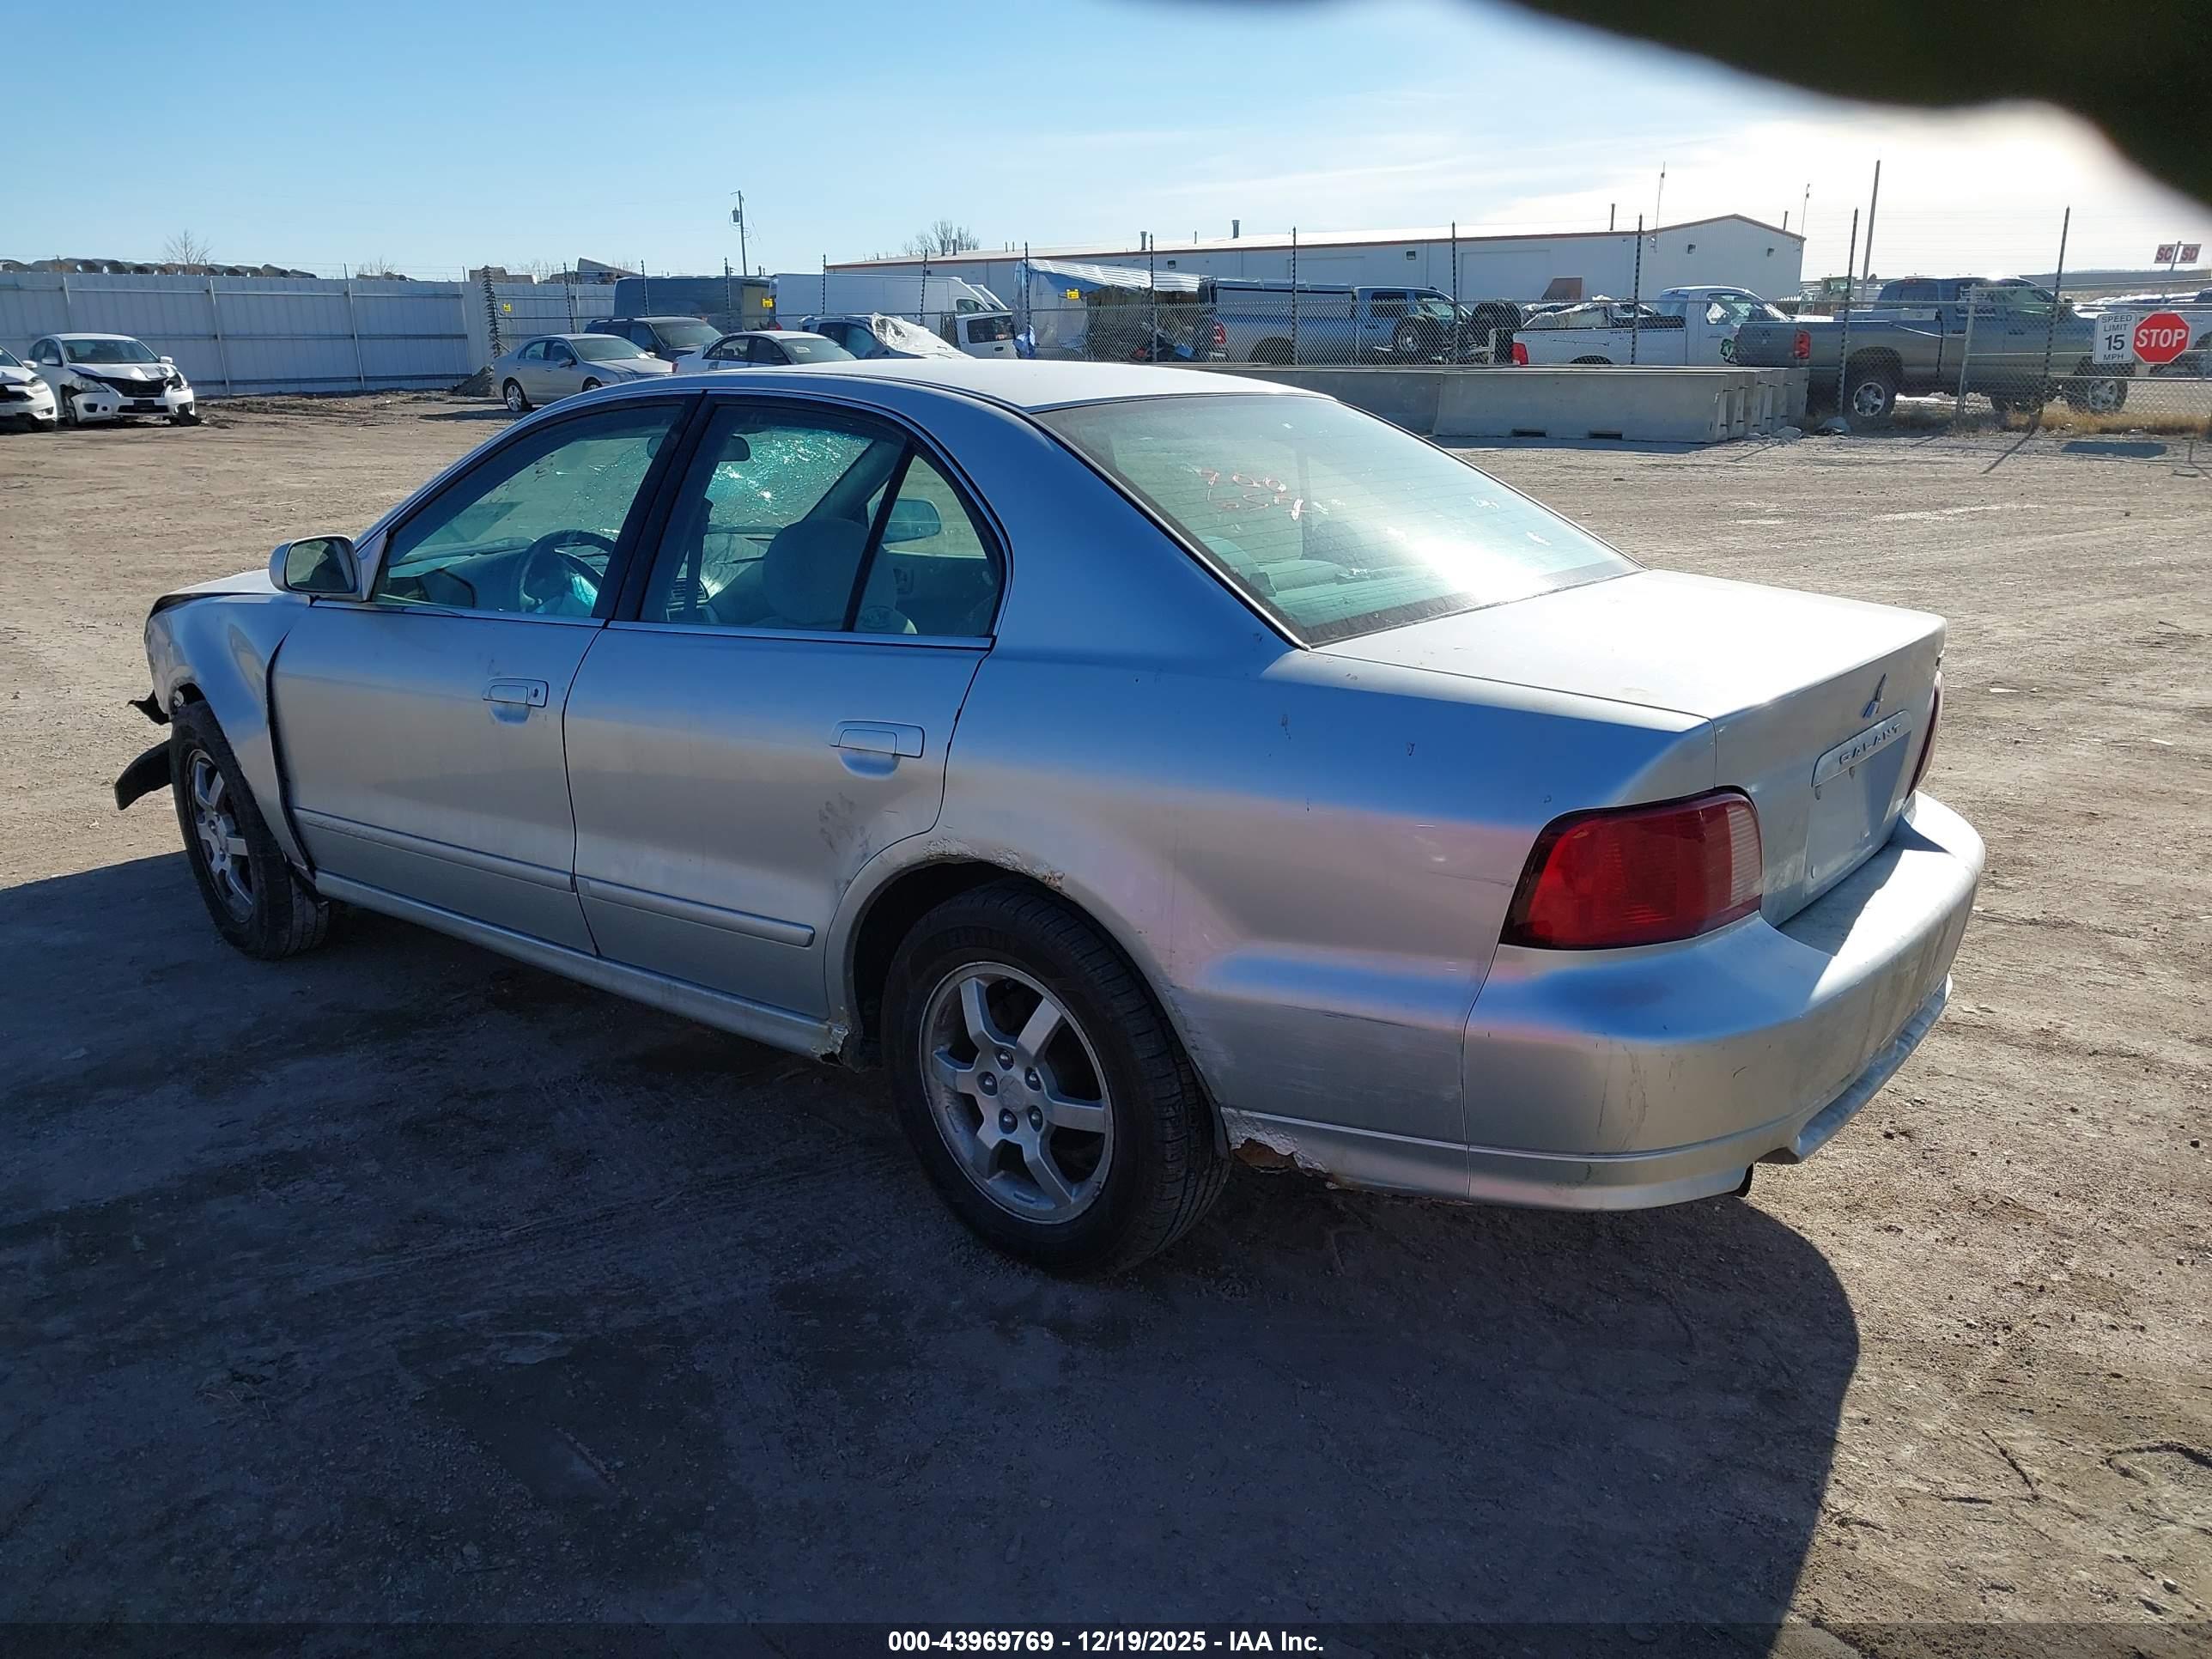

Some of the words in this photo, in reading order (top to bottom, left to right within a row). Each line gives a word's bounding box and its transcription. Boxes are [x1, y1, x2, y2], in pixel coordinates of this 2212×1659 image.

[2101, 314, 2132, 323] SPEED
[2104, 324, 2129, 332] LIMIT
[2105, 334, 2125, 351] 15
[2136, 328, 2186, 348] STOP
[1838, 723, 1901, 765] GALANT
